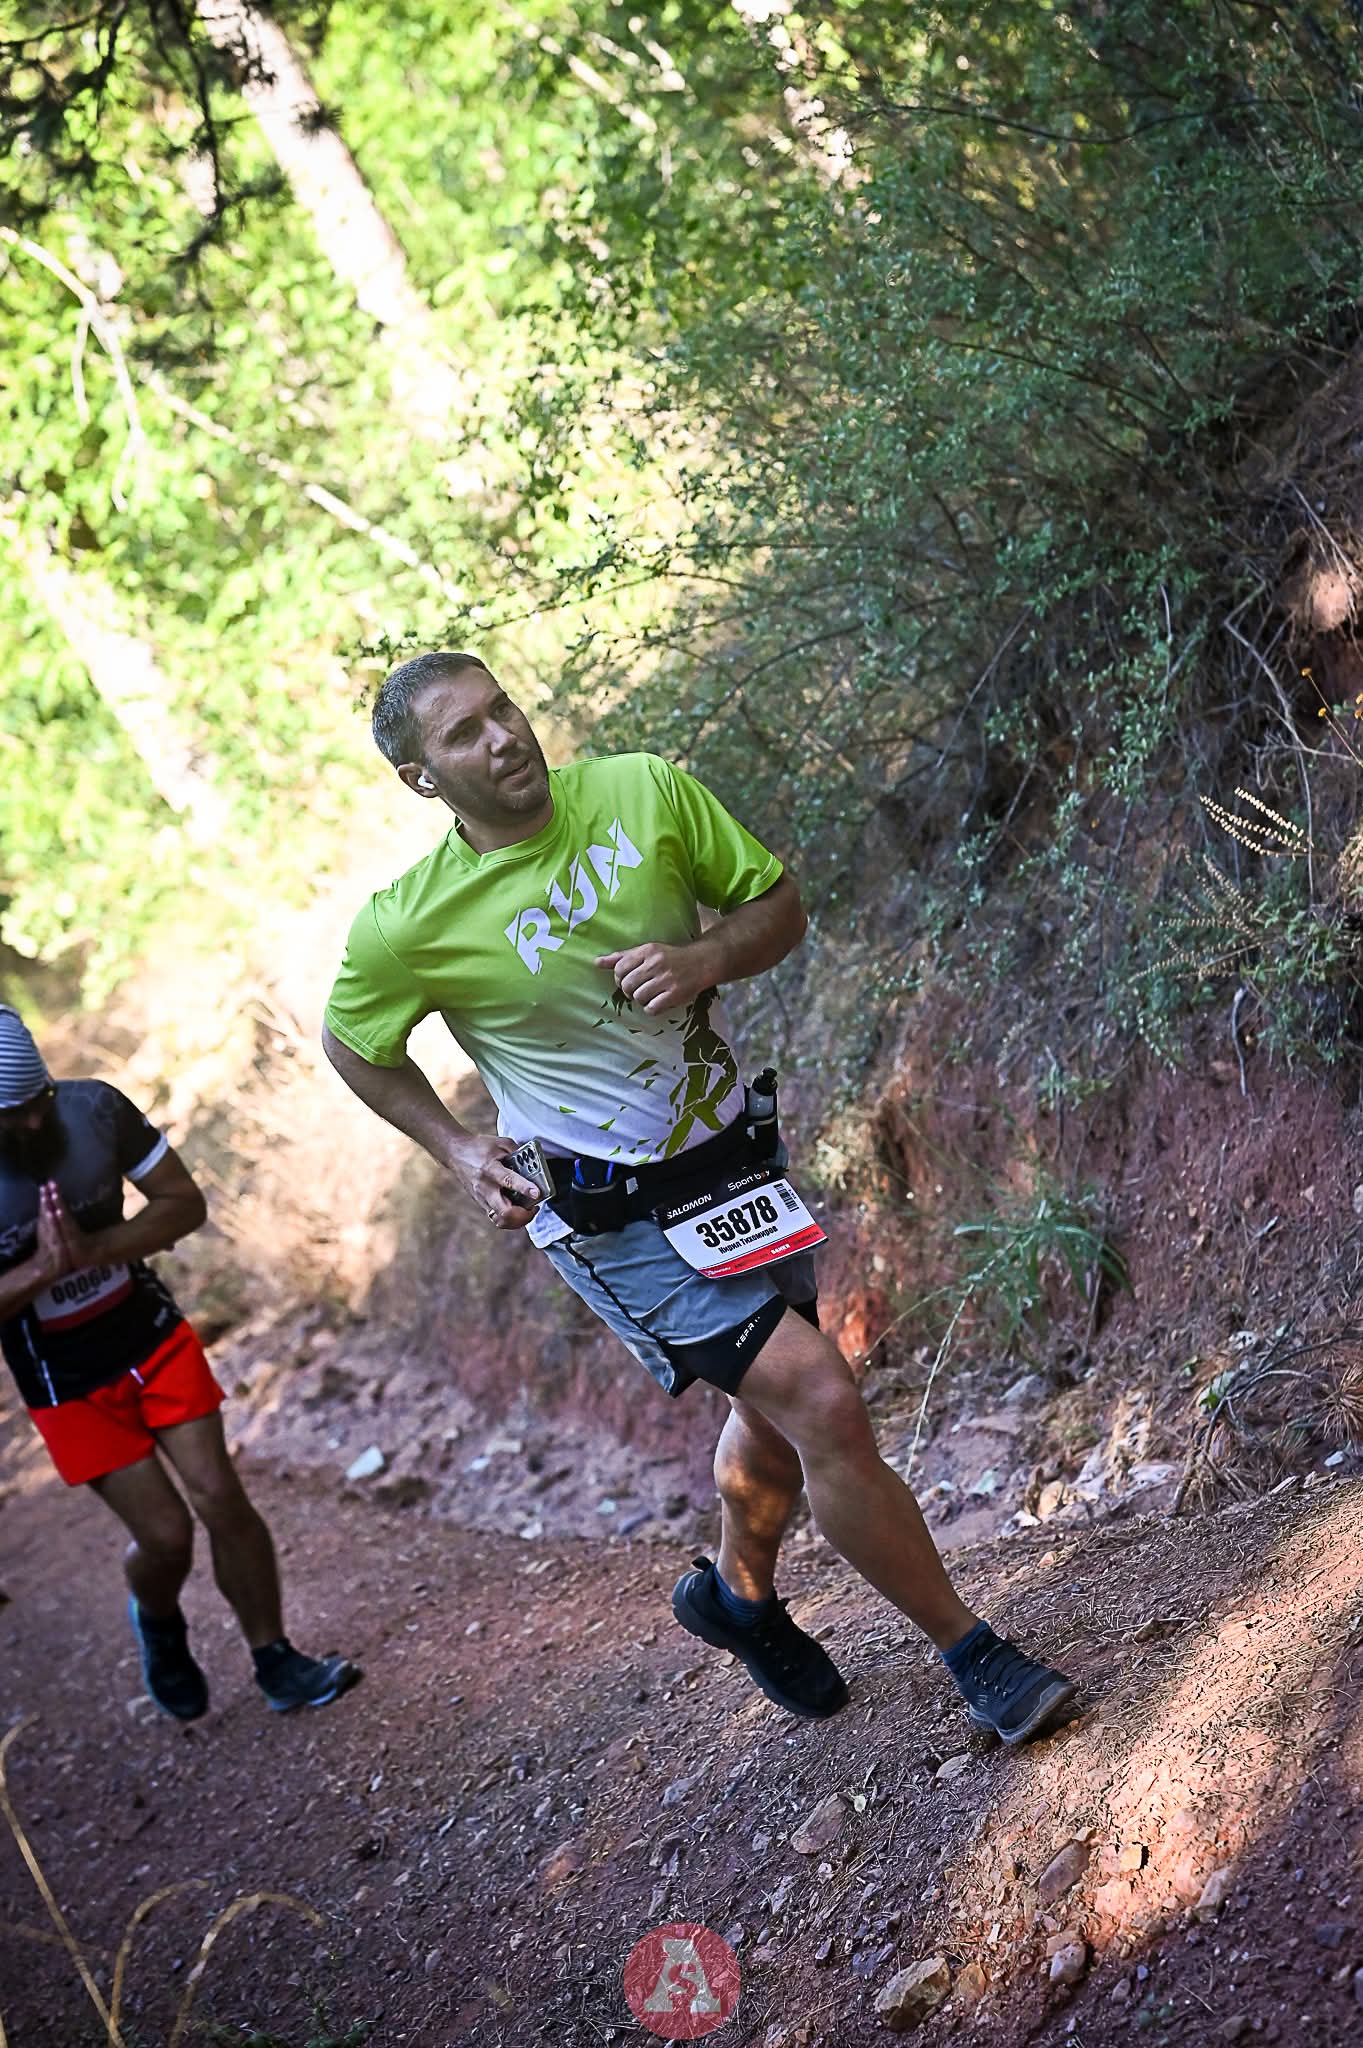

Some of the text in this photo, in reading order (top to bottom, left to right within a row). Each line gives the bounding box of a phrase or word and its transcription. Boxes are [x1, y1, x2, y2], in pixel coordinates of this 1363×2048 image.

[503, 816, 644, 976] RUN
[727, 1175, 754, 1192] Sport
[666, 1193, 713, 1220] SALOMON
[695, 1195, 779, 1249] 35878
